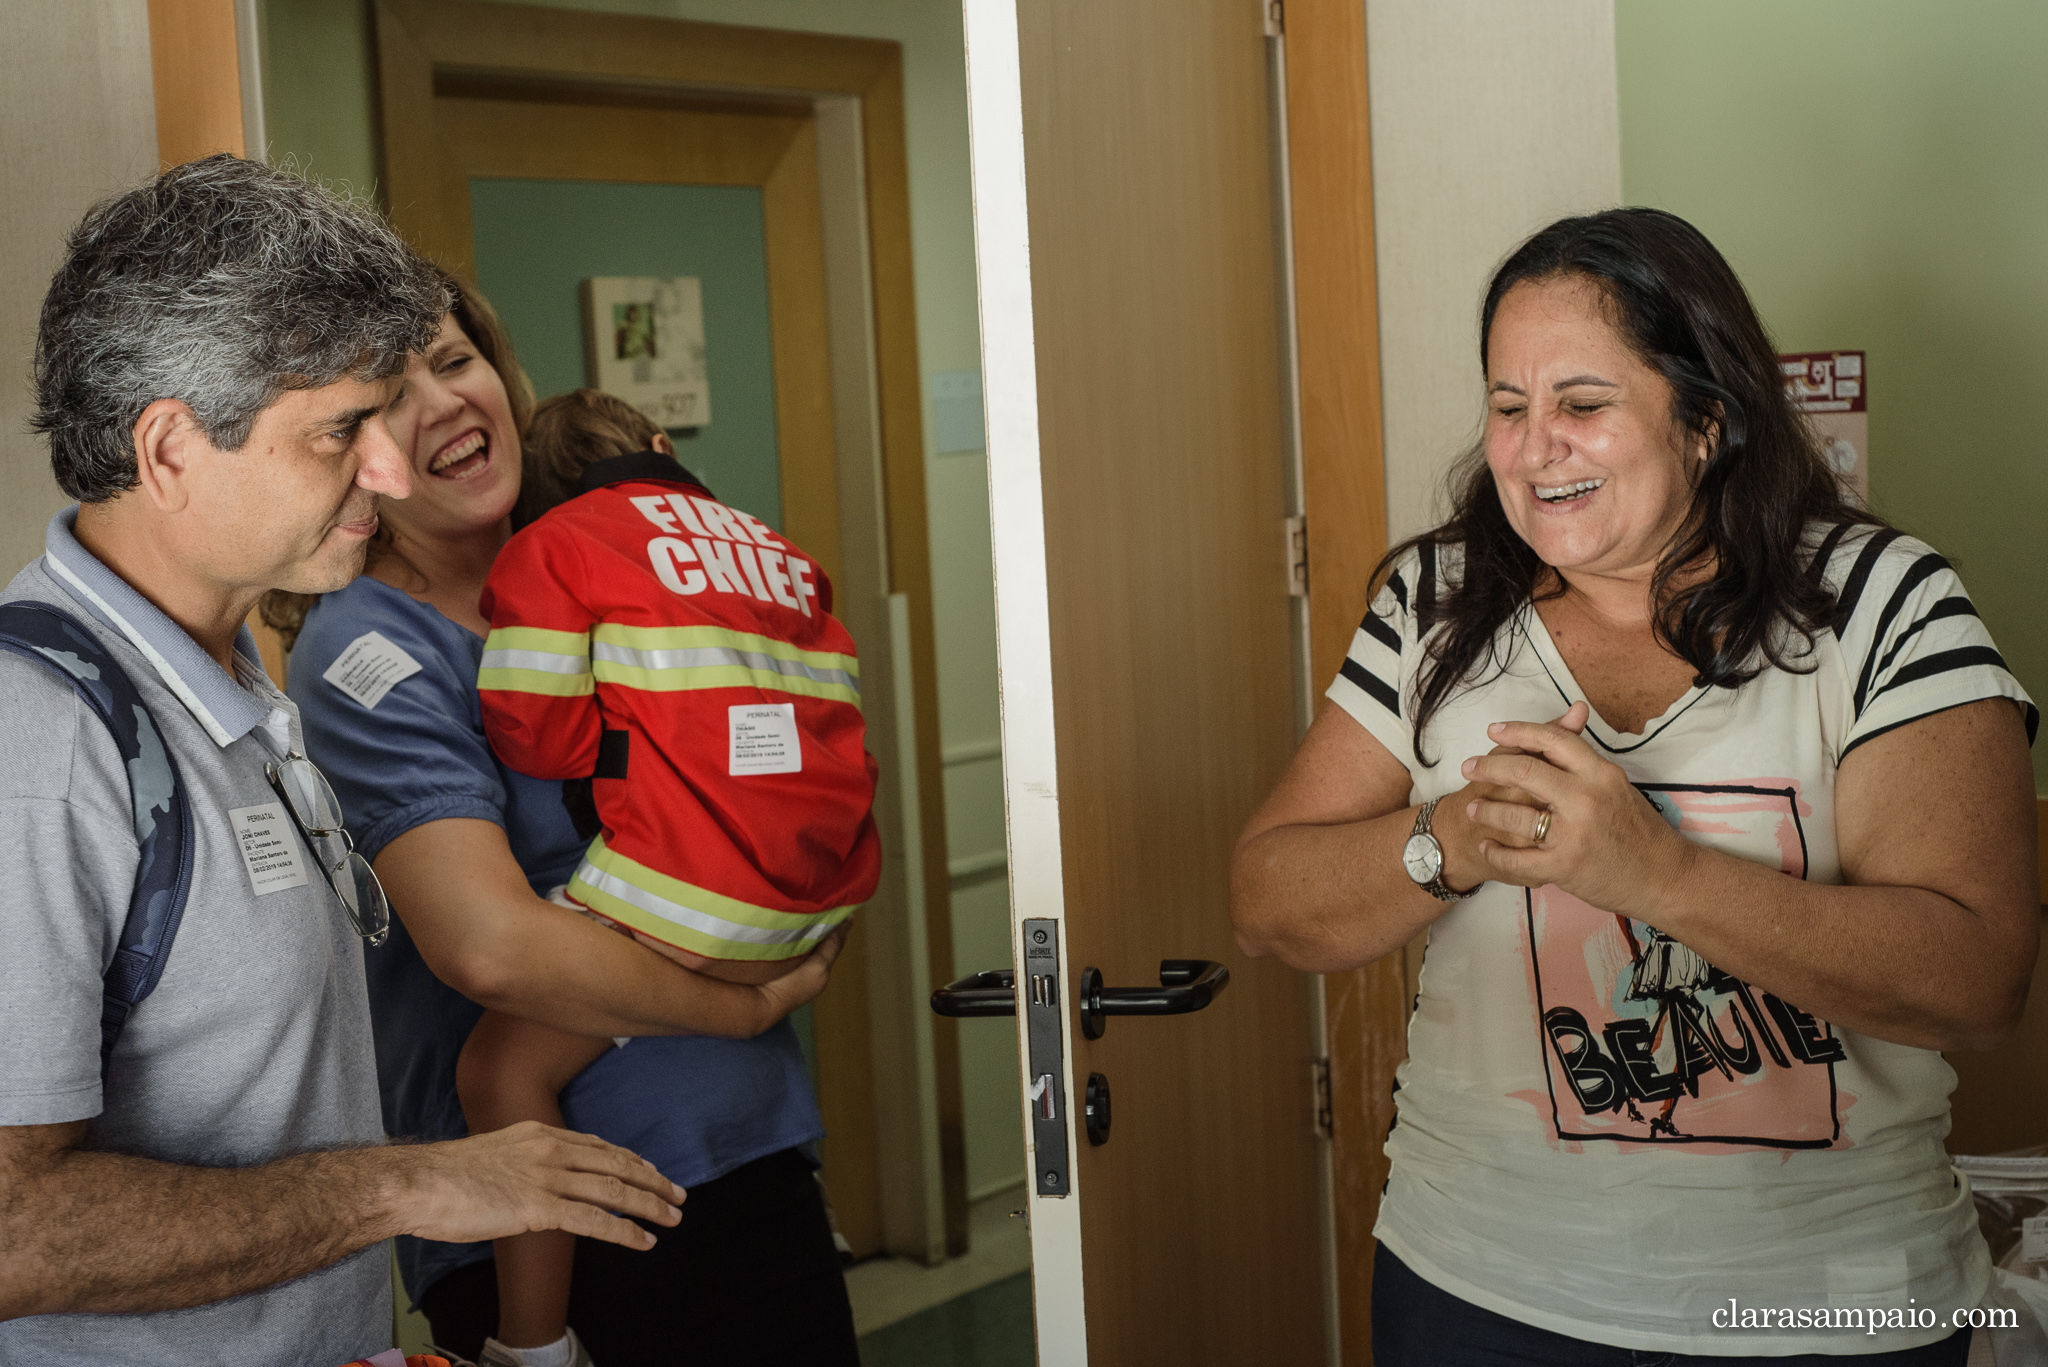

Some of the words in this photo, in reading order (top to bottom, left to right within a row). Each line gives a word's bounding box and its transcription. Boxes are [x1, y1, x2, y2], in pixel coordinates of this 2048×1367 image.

[629, 493, 786, 550] FIRE
[647, 536, 815, 618] CHIEF
[246, 812, 275, 823] PERINATAL
